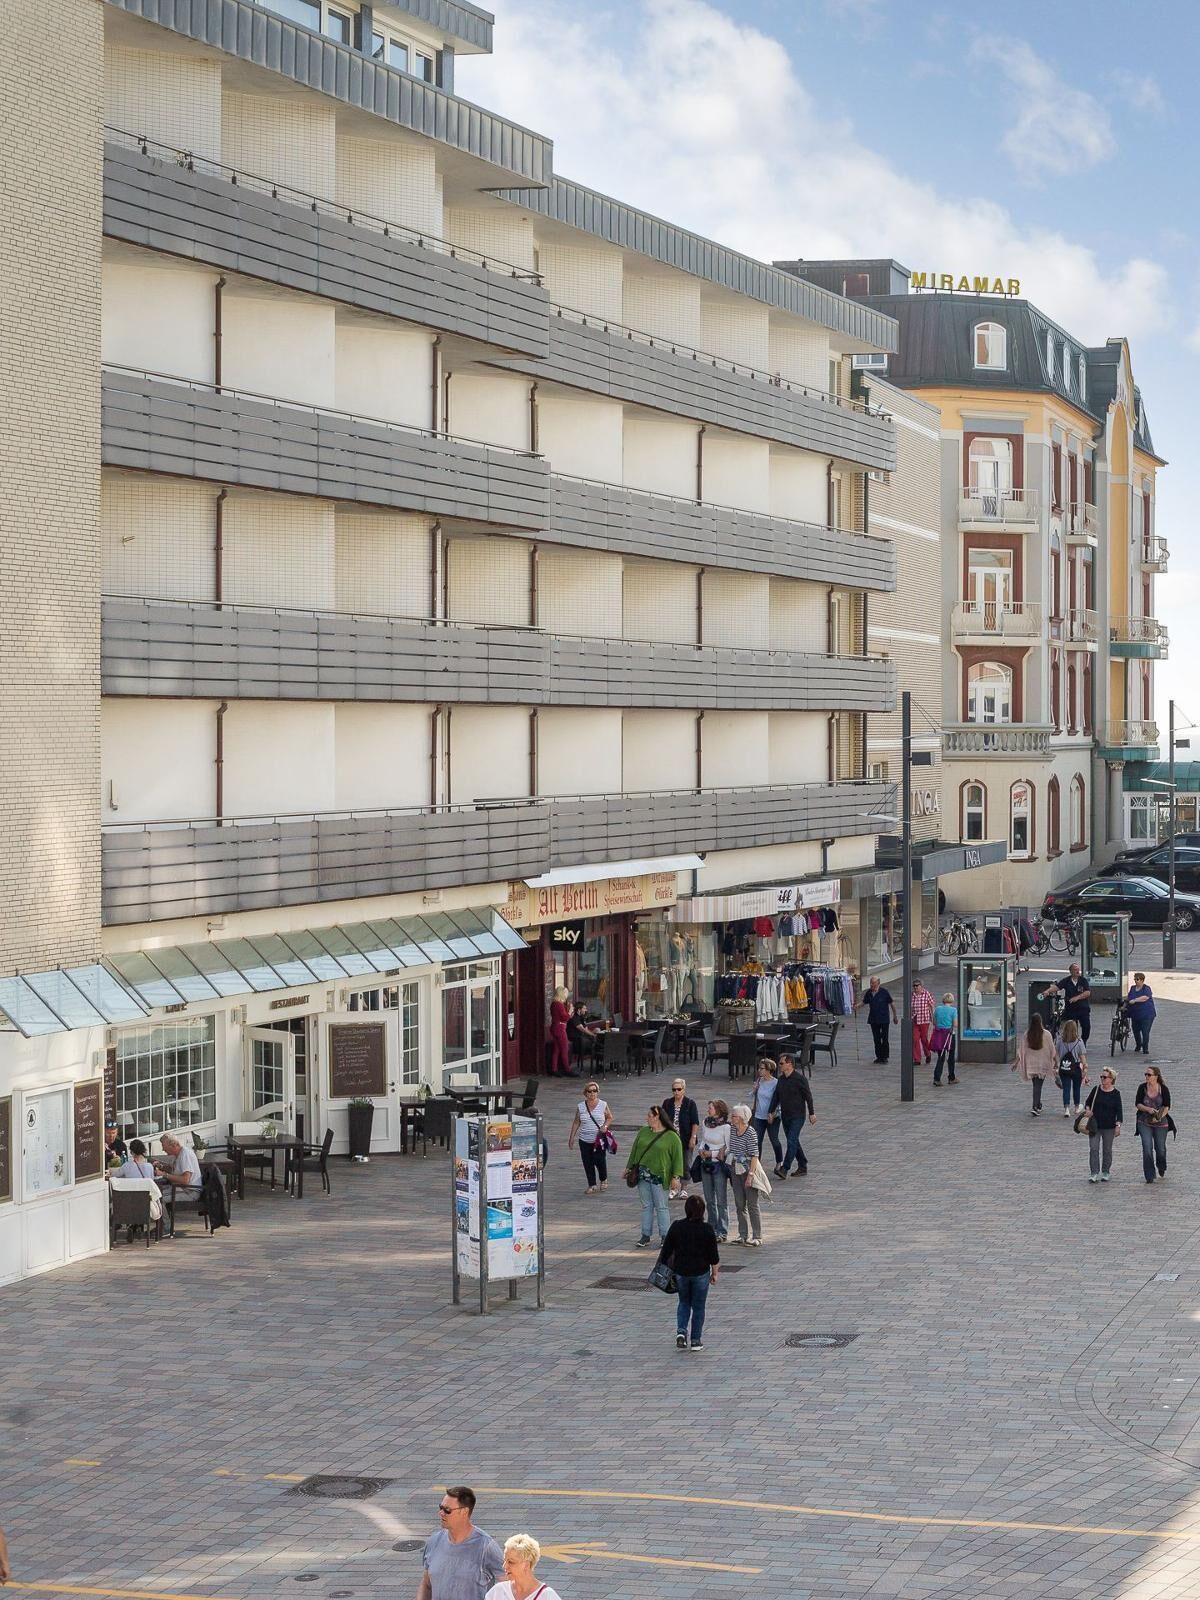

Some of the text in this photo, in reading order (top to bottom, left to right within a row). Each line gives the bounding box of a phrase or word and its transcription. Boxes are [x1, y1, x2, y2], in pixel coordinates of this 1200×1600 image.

[911, 271, 1020, 296] MIRAMAR
[965, 850, 981, 868] INGA
[538, 882, 598, 917] Alt Berlin
[553, 926, 581, 945] sky
[269, 995, 310, 1010] RESTAURANT
